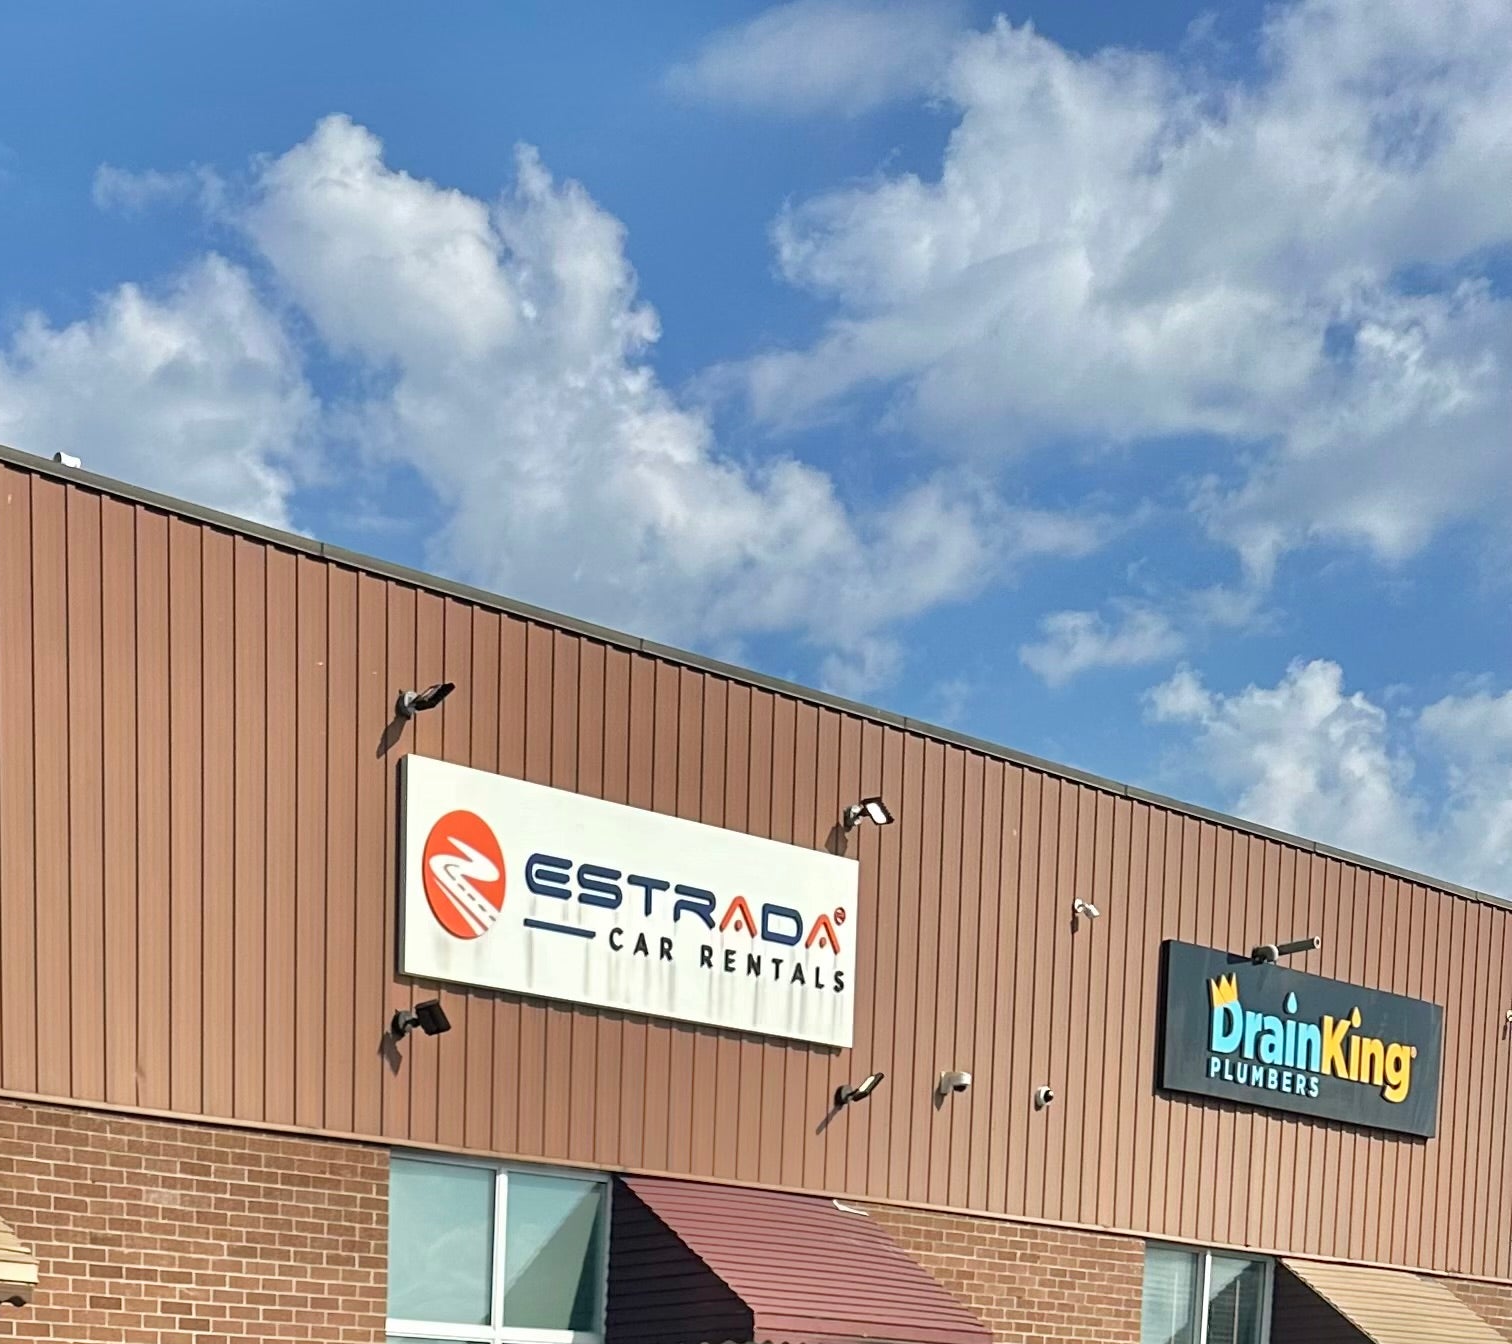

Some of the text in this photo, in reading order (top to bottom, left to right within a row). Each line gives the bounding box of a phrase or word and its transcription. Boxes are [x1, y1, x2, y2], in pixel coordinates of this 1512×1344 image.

[525, 852, 841, 956] ESTRADA
[608, 927, 845, 994] CAR RENTALS
[1209, 1056, 1320, 1099] PLUMBERS
[1210, 991, 1415, 1104] DrainKing
